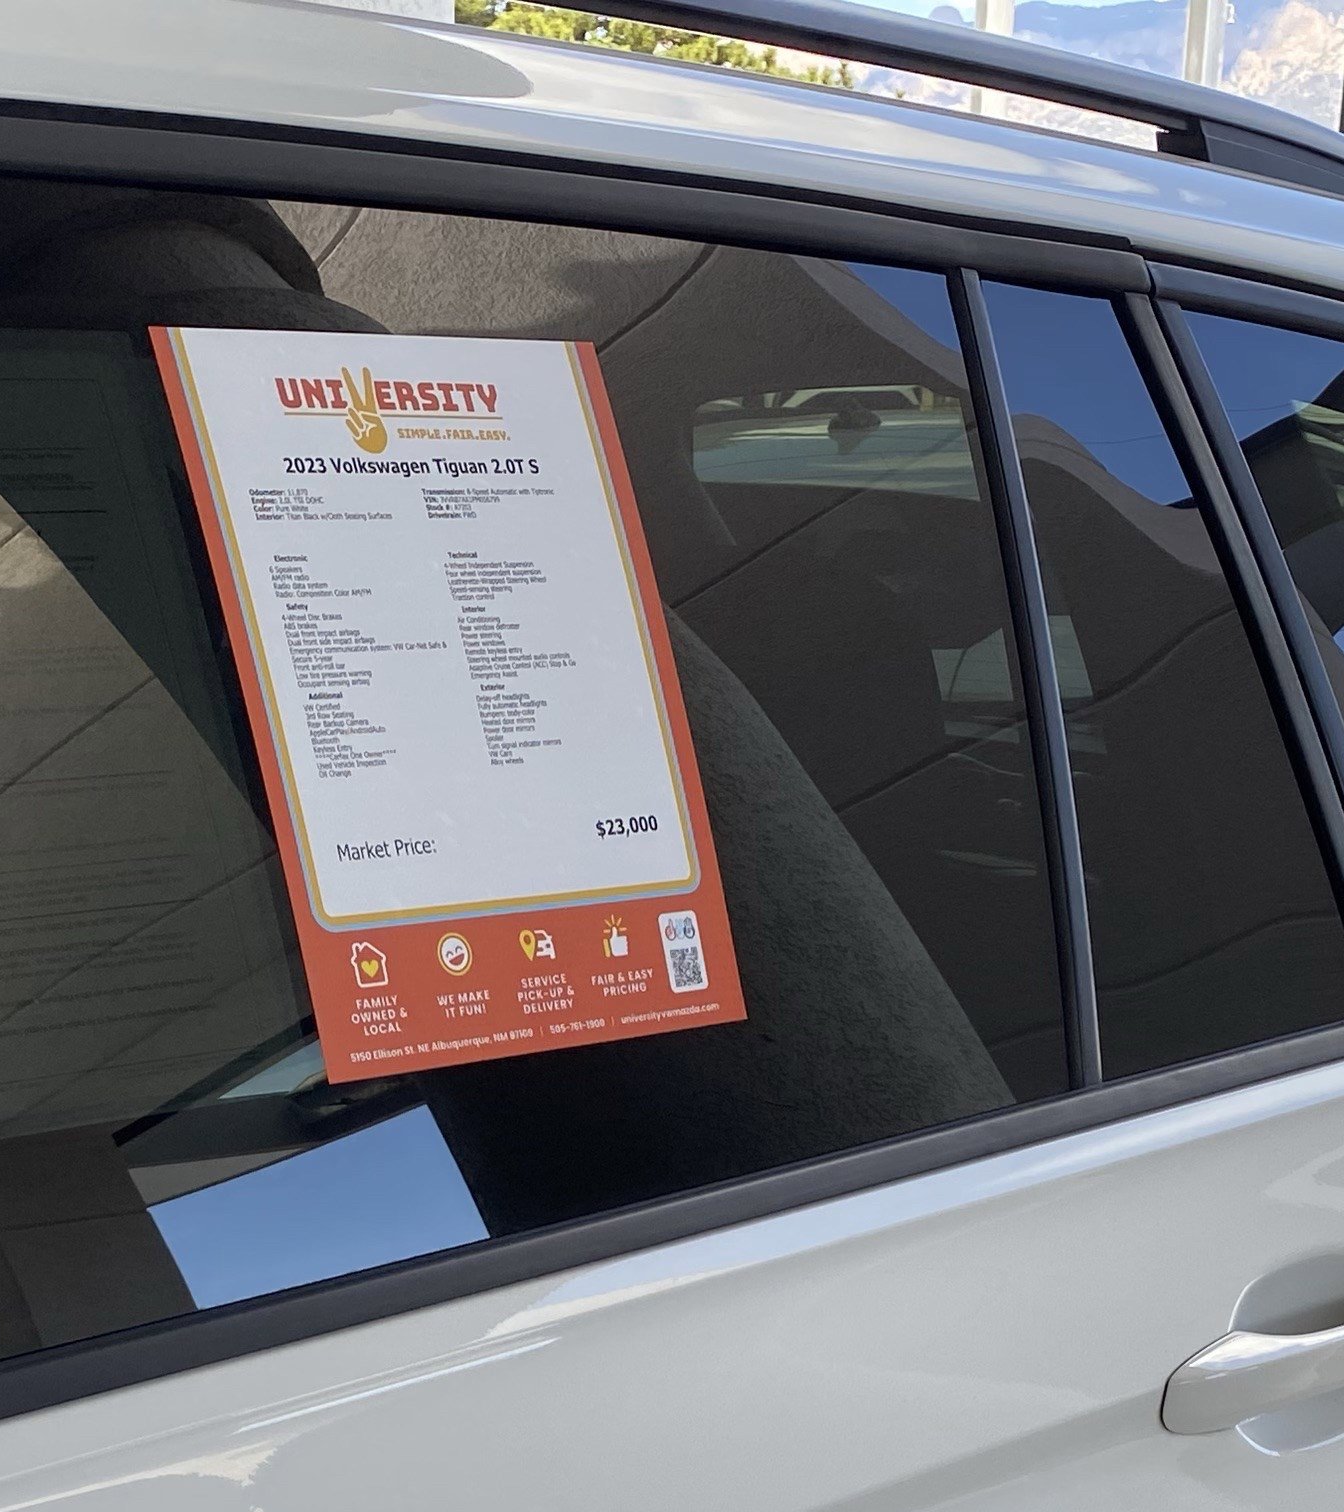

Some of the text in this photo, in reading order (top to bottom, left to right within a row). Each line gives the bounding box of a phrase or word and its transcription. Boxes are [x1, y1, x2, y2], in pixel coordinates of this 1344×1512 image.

[283, 457, 540, 477] 2023 Volkswagen Tiguan 2.0T S
[274, 566, 303, 575] Speakers
[286, 603, 308, 612] Safety
[307, 692, 343, 700] Additional
[322, 720, 344, 729] Backup
[345, 718, 369, 726] Camera
[312, 744, 353, 755] Keyless Entry
[355, 758, 386, 768] Inspection
[328, 769, 352, 779] Change
[336, 815, 658, 862] Market Price: $23,000
[520, 972, 567, 988] SERVICE
[590, 968, 654, 986] FAIR & EASY
[516, 985, 574, 1003] PICK-UP &
[602, 981, 647, 997] PRICING
[355, 994, 398, 1010] FAMILY
[436, 989, 490, 1006] WE MAKE
[444, 1003, 486, 1018] IT FUN!
[522, 998, 574, 1014] DELIVERY
[350, 1007, 408, 1024] OWNED &
[363, 1021, 401, 1036] LOCAL
[349, 1050, 372, 1063] 5150
[372, 1046, 403, 1059] Ellison
[417, 1042, 429, 1053] NE
[430, 1033, 492, 1052] Albuquerque,
[492, 1030, 508, 1042] NM
